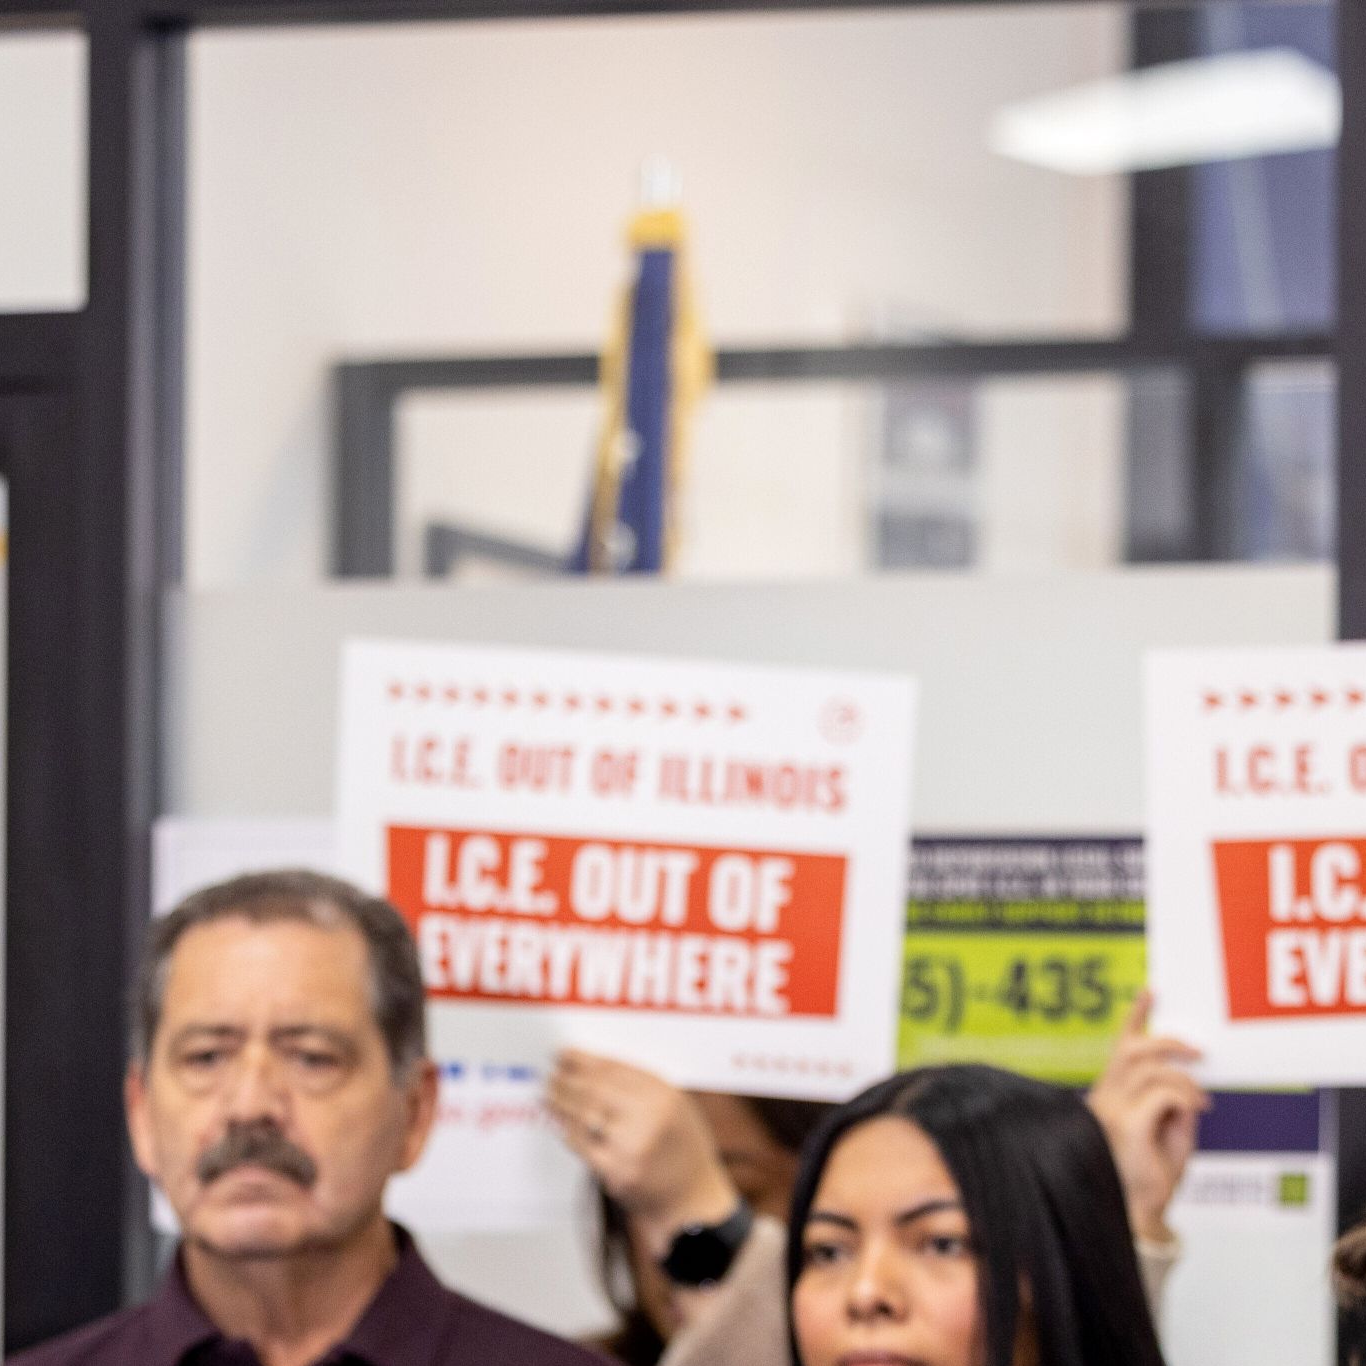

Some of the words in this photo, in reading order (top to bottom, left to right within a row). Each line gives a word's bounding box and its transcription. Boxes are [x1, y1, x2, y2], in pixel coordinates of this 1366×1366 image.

[391, 733, 481, 790] I.C.E.
[497, 741, 574, 797] OUT
[590, 745, 645, 801] OF
[657, 755, 850, 815] ILLINOIS
[1213, 742, 1333, 797] I.C.E.
[422, 833, 559, 917] I.C.E.
[570, 843, 699, 926] OUT
[707, 852, 795, 934] OF
[420, 912, 793, 1018] EVERYWHERE
